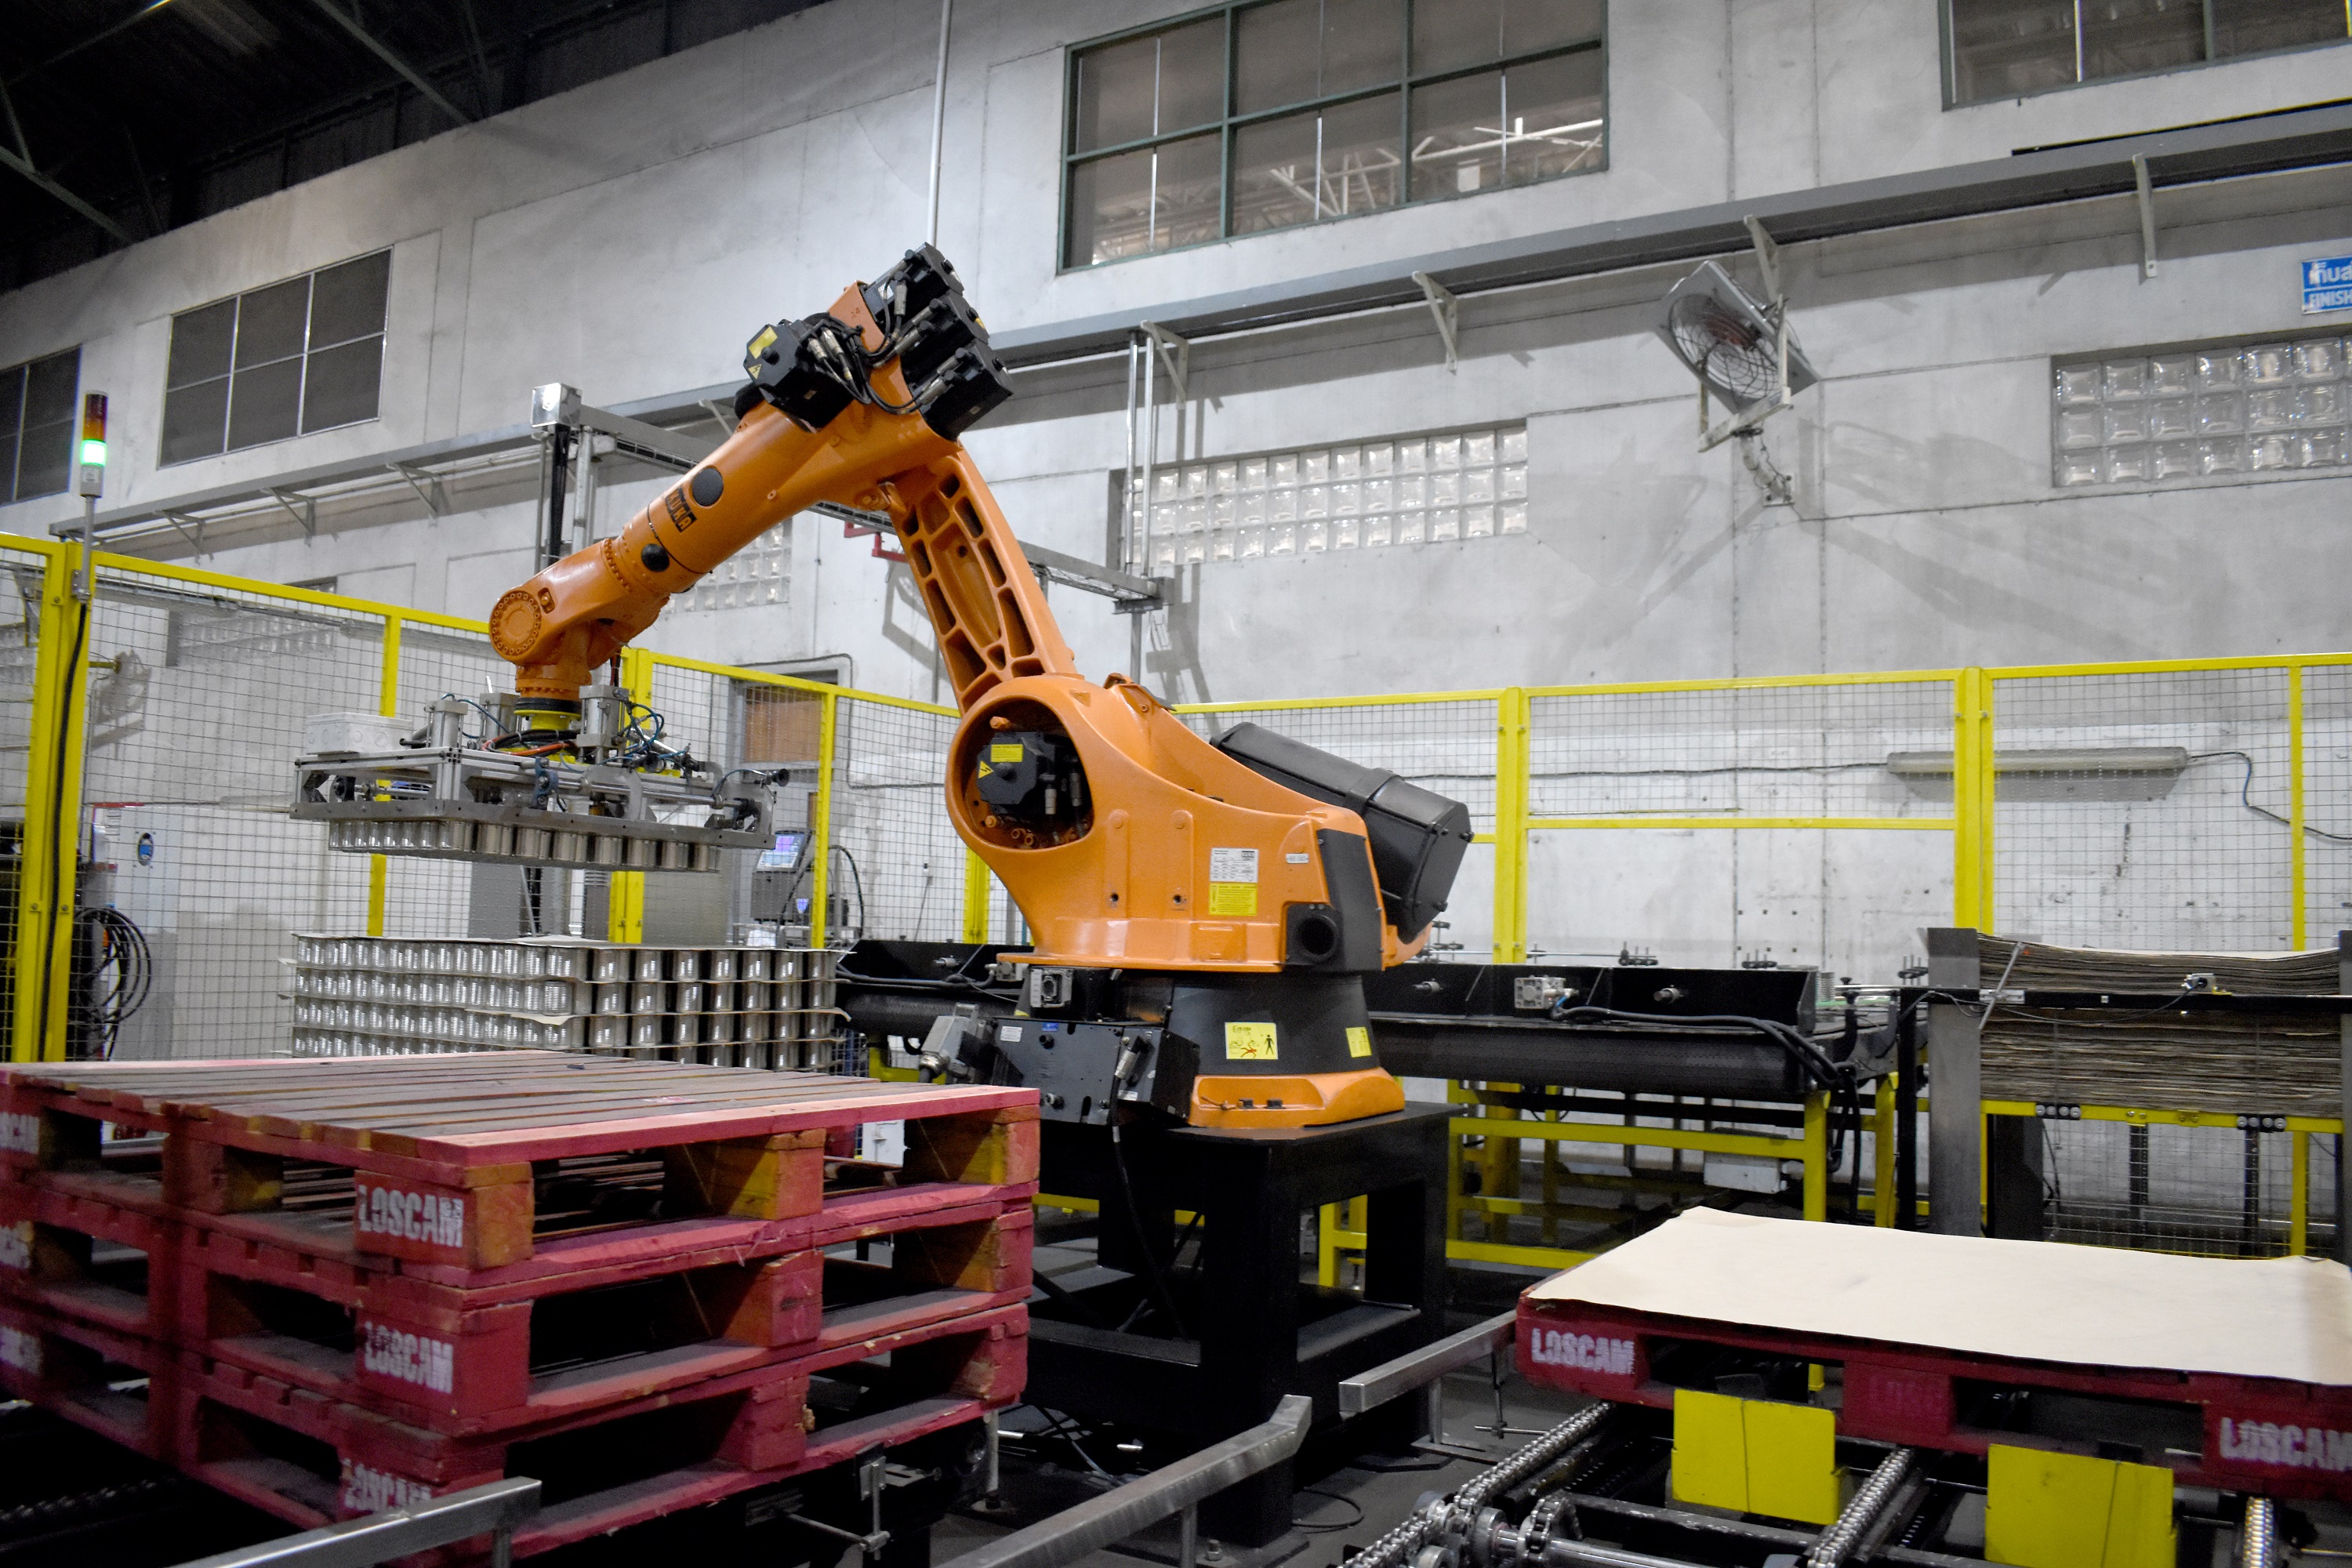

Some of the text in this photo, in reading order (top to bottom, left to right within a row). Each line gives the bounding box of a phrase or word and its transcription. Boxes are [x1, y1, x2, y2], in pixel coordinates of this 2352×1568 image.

[665, 485, 698, 533] KUKA
[358, 1185, 464, 1248] LOSCAM
[1531, 1327, 1635, 1375] LOSCAM
[2220, 1417, 2352, 1472] LOSCAM
